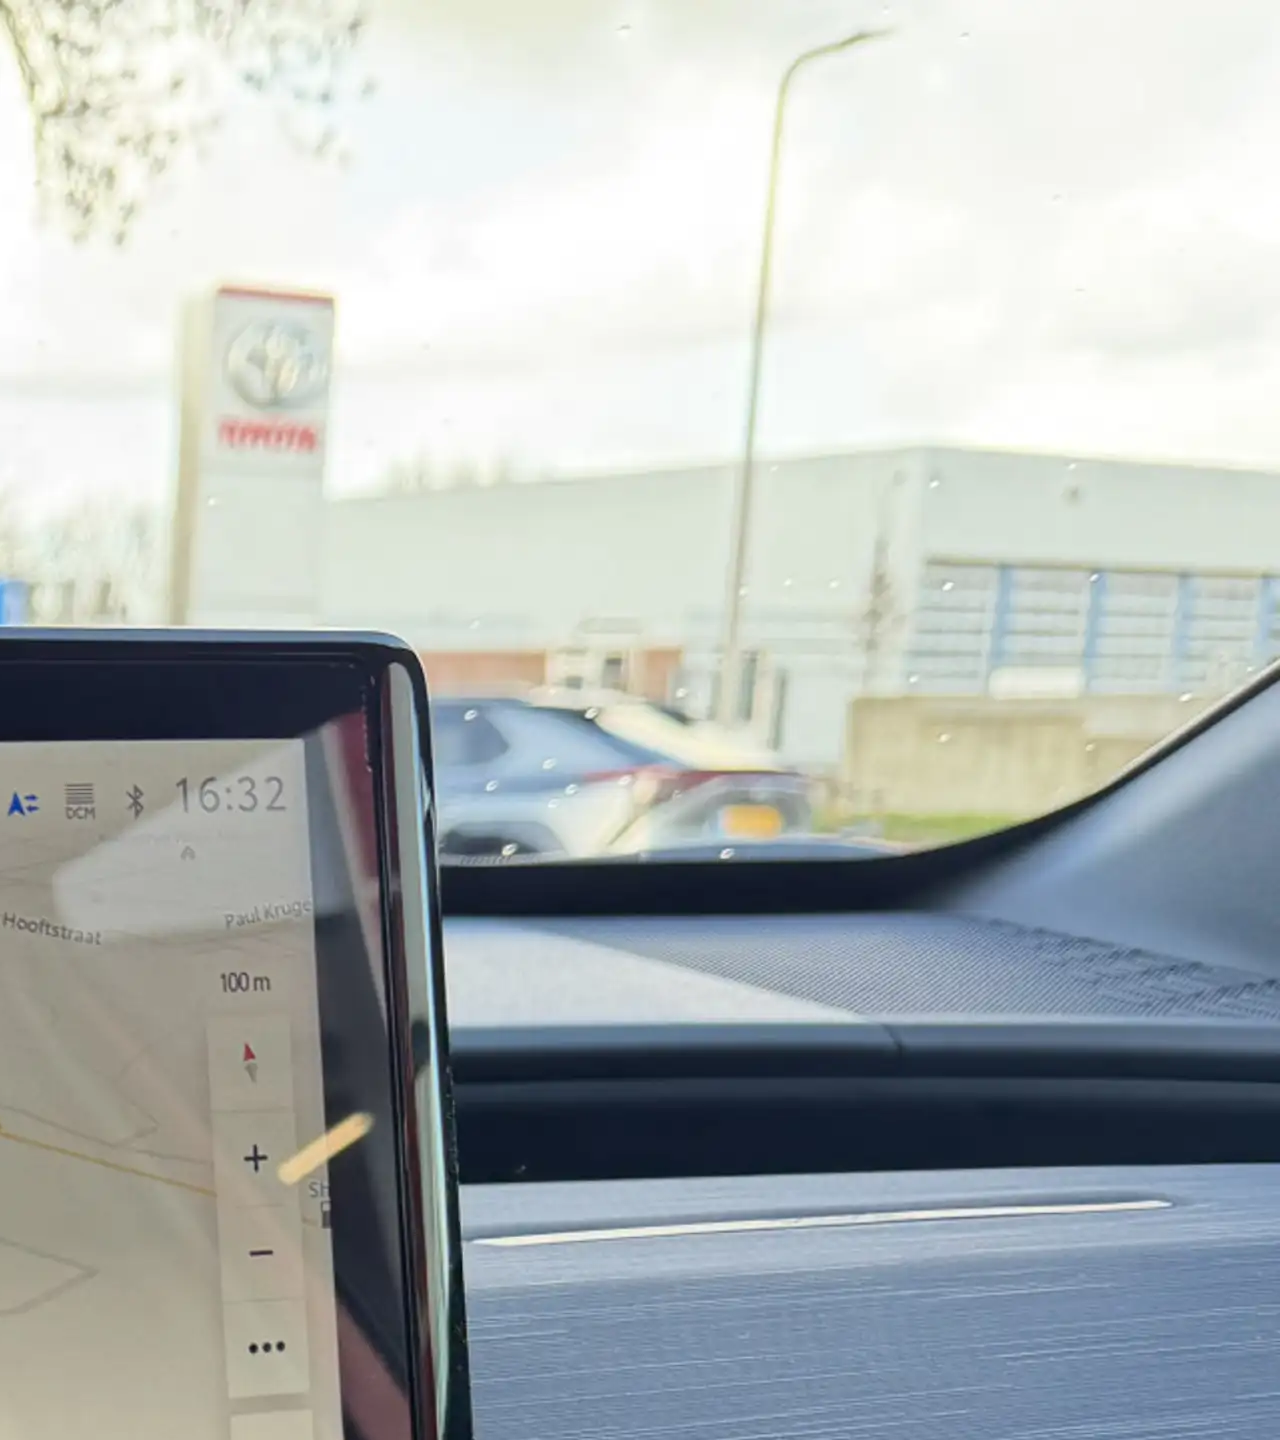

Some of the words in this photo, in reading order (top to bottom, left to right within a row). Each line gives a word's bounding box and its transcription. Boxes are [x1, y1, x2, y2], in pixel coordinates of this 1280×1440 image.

[176, 776, 287, 813] 16:32
[3, 911, 102, 946] Hooftstraat
[224, 906, 261, 930] Paul
[220, 973, 249, 992] 100
[253, 977, 271, 991] m
